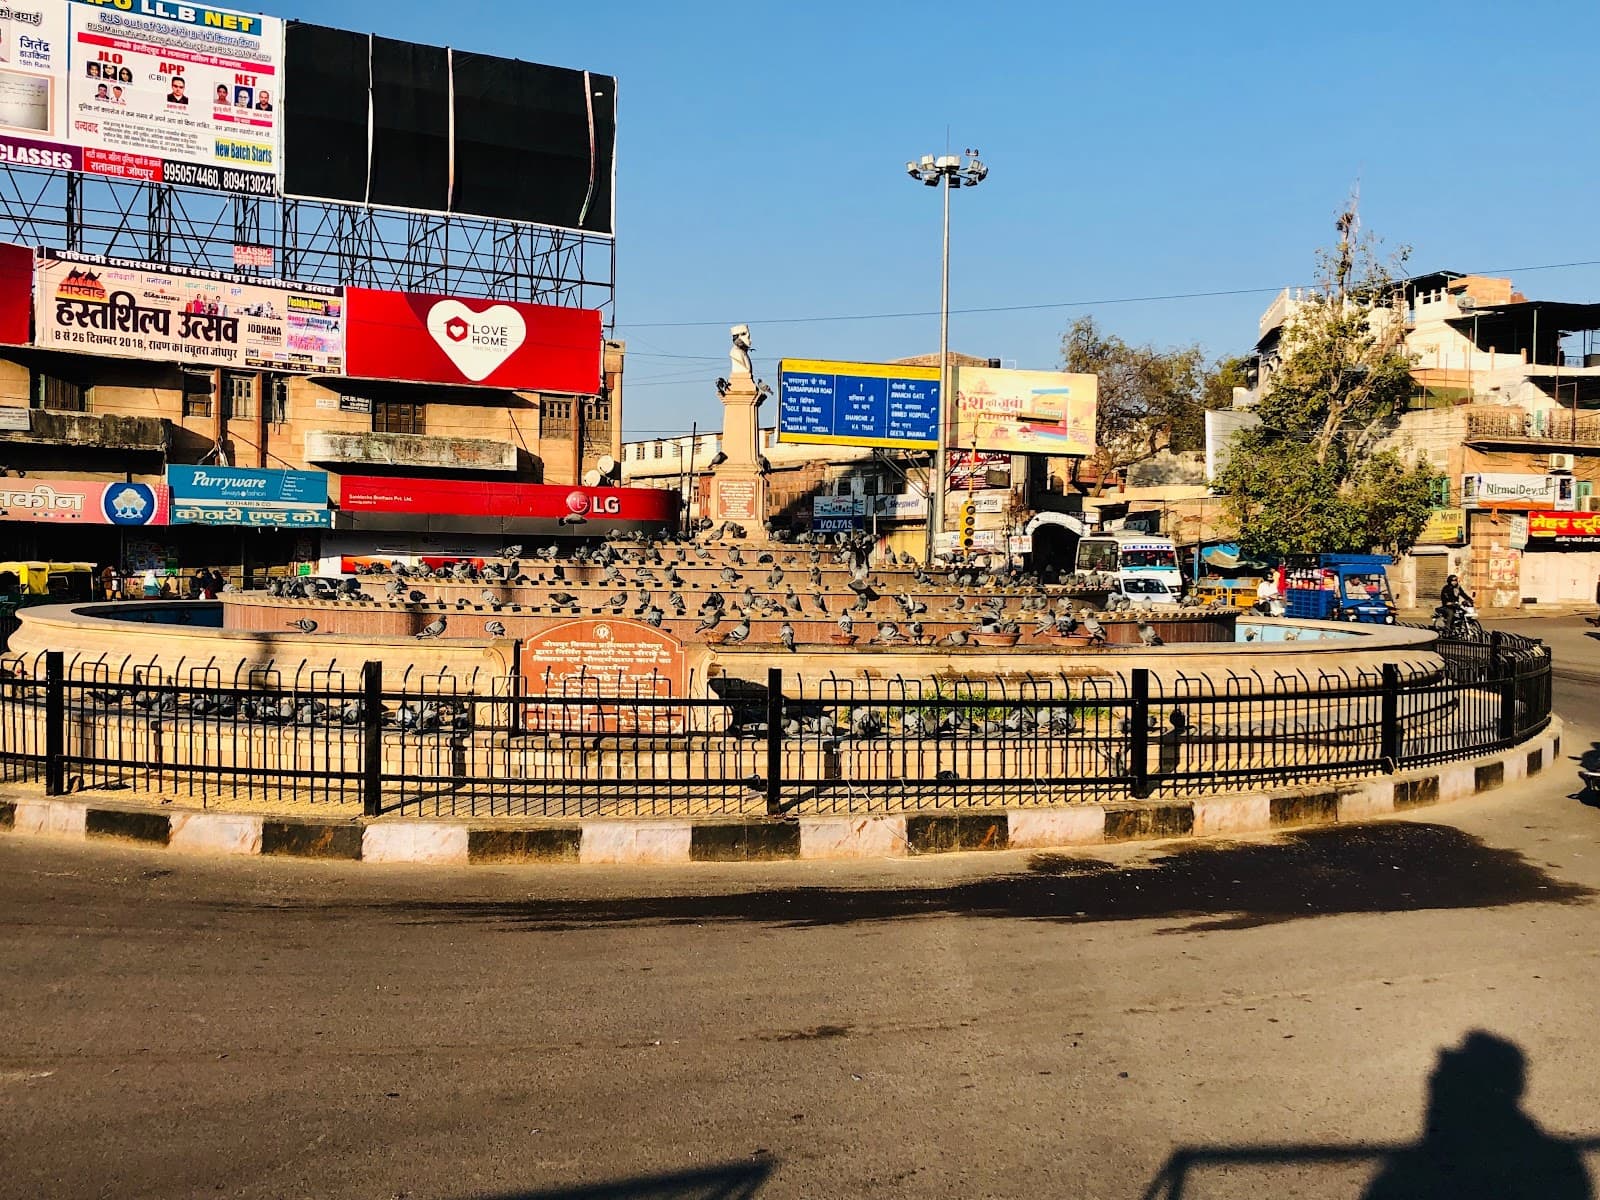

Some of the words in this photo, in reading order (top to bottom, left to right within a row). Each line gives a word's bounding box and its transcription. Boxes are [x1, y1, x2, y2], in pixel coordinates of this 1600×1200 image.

[100, 12, 120, 24] RJS
[204, 11, 254, 32] NET
[97, 51, 122, 65] JLO
[159, 62, 184, 75] APP
[234, 73, 257, 86] NET
[215, 140, 229, 156] New
[231, 143, 251, 160] Batch
[252, 146, 272, 163] Starts
[224, 172, 276, 195] 8094130241
[234, 245, 272, 256] CLASSIC
[55, 250, 106, 265] पश्चिमी
[108, 257, 166, 272] राजस्थान
[170, 263, 188, 275] का
[190, 266, 220, 280] सबसे
[305, 282, 335, 294] उत्सव
[59, 283, 106, 300] मारवाड़
[55, 291, 171, 337] हस्तशिल्प
[178, 311, 239, 343] उत्सव
[247, 323, 281, 336] JODHANA
[472, 324, 507, 336] LOVE
[55, 330, 60, 340] 8
[63, 328, 71, 341] से
[72, 332, 84, 343] 26
[86, 331, 117, 347] दिसम्बर
[119, 336, 146, 351] 2018,
[148, 340, 170, 352] रावण
[171, 342, 183, 353] का
[210, 344, 237, 361] जोधपुर
[472, 336, 507, 346] HOME
[955, 391, 983, 411] देश
[192, 471, 266, 489] Parryware
[1486, 483, 1549, 495] NirmalDev.us
[593, 496, 619, 513] LG
[175, 508, 243, 522] कोठारी
[248, 511, 289, 522] एण्ड
[292, 511, 327, 523] को.
[1531, 514, 1570, 528] मेहर
[820, 519, 853, 529] VOLTAS
